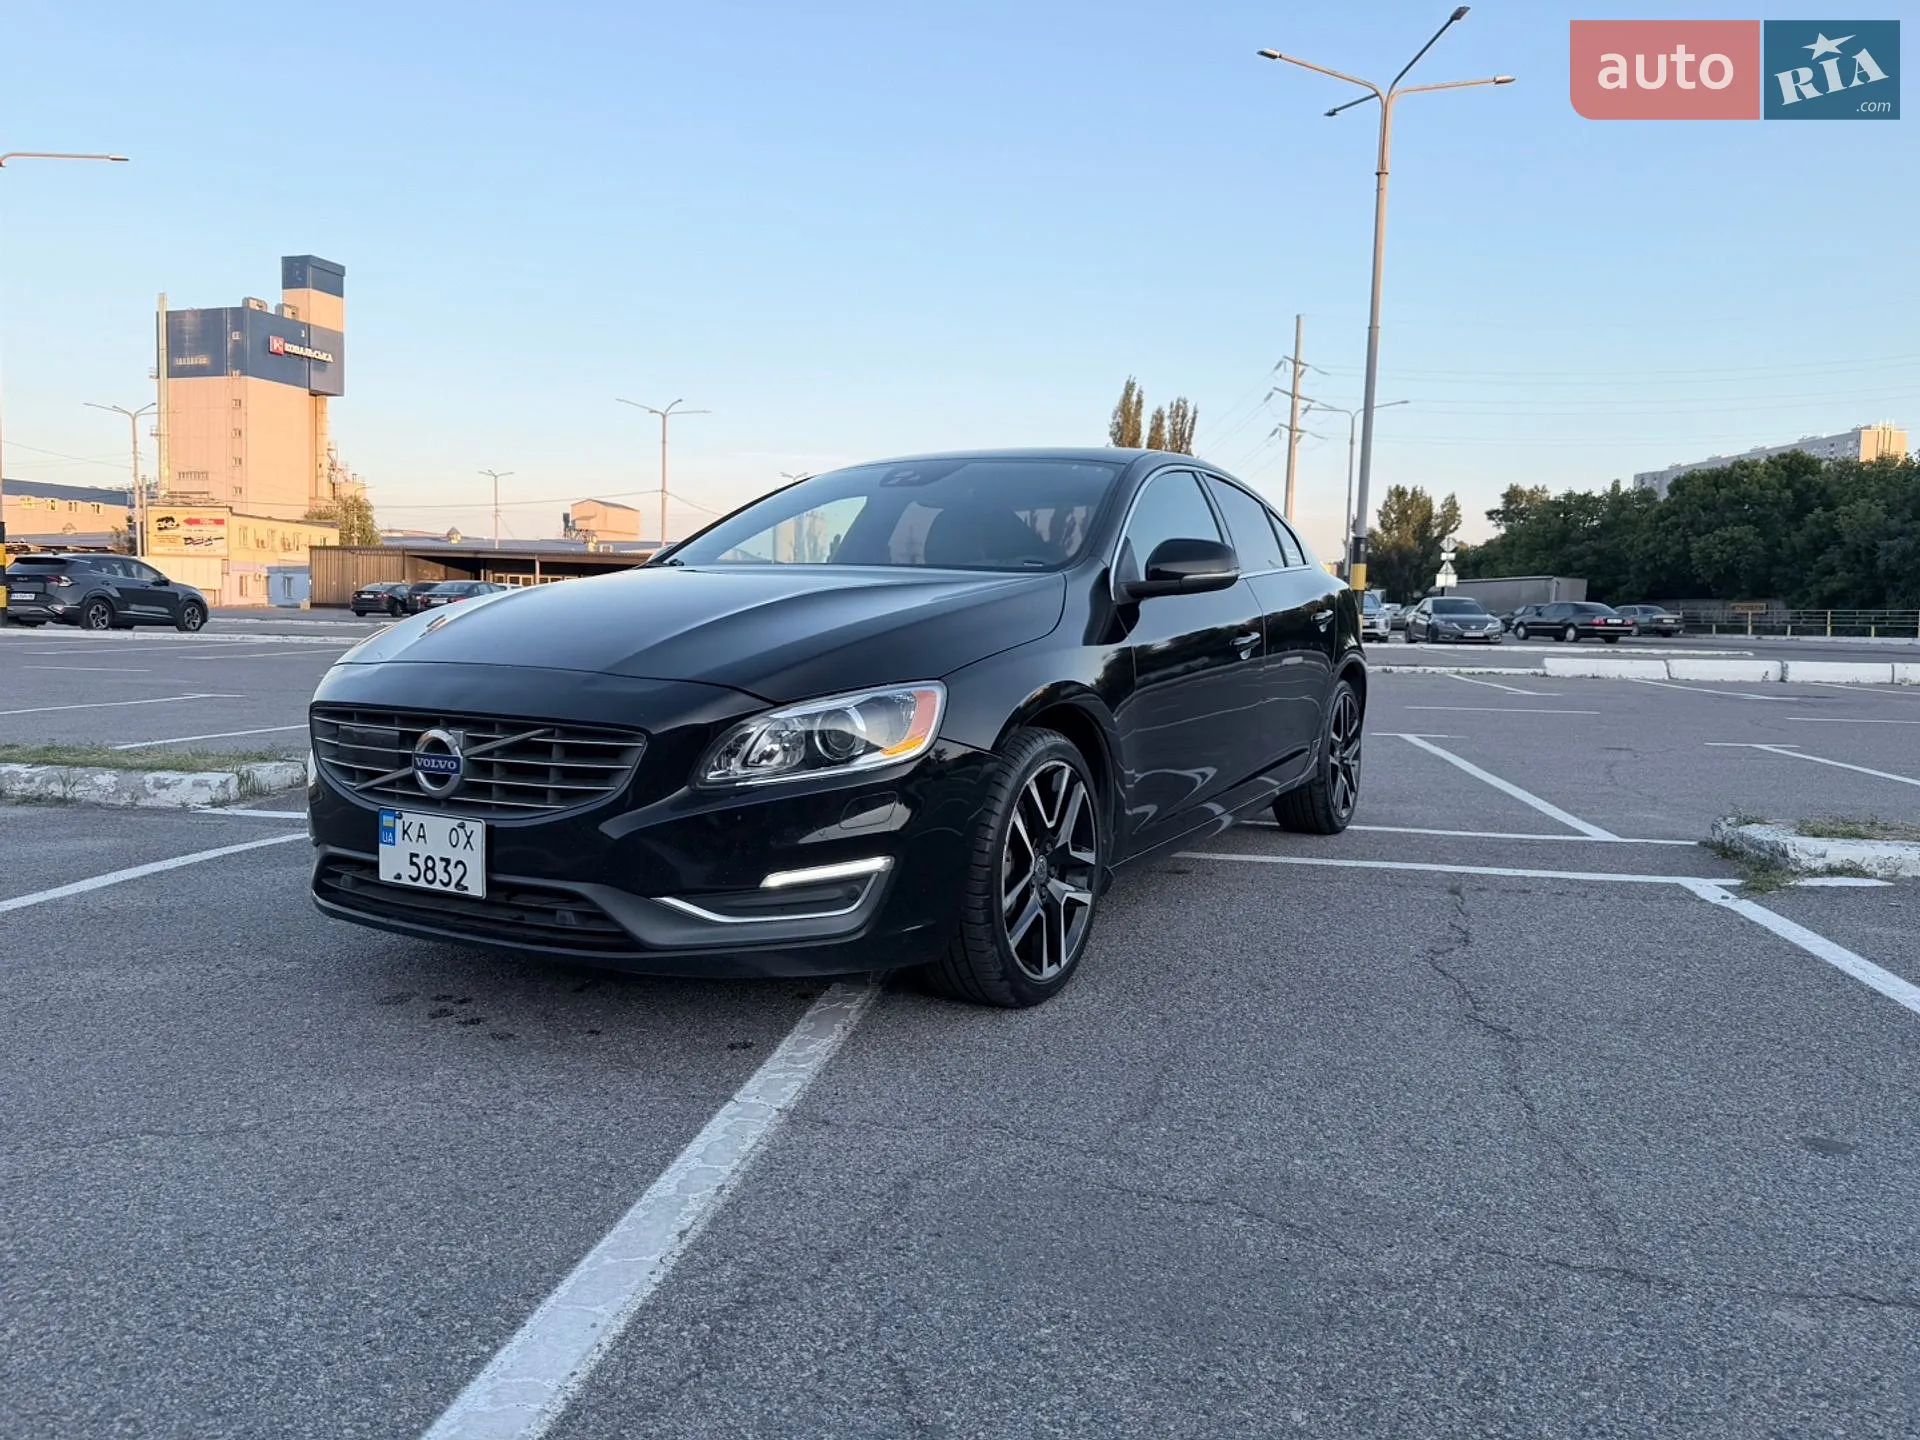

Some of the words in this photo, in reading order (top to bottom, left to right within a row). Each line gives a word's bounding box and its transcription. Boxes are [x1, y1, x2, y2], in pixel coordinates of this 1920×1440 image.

[415, 757, 457, 770] VOLVO
[382, 831, 393, 843] UA
[402, 820, 427, 844] KA
[408, 852, 468, 891] 5832
